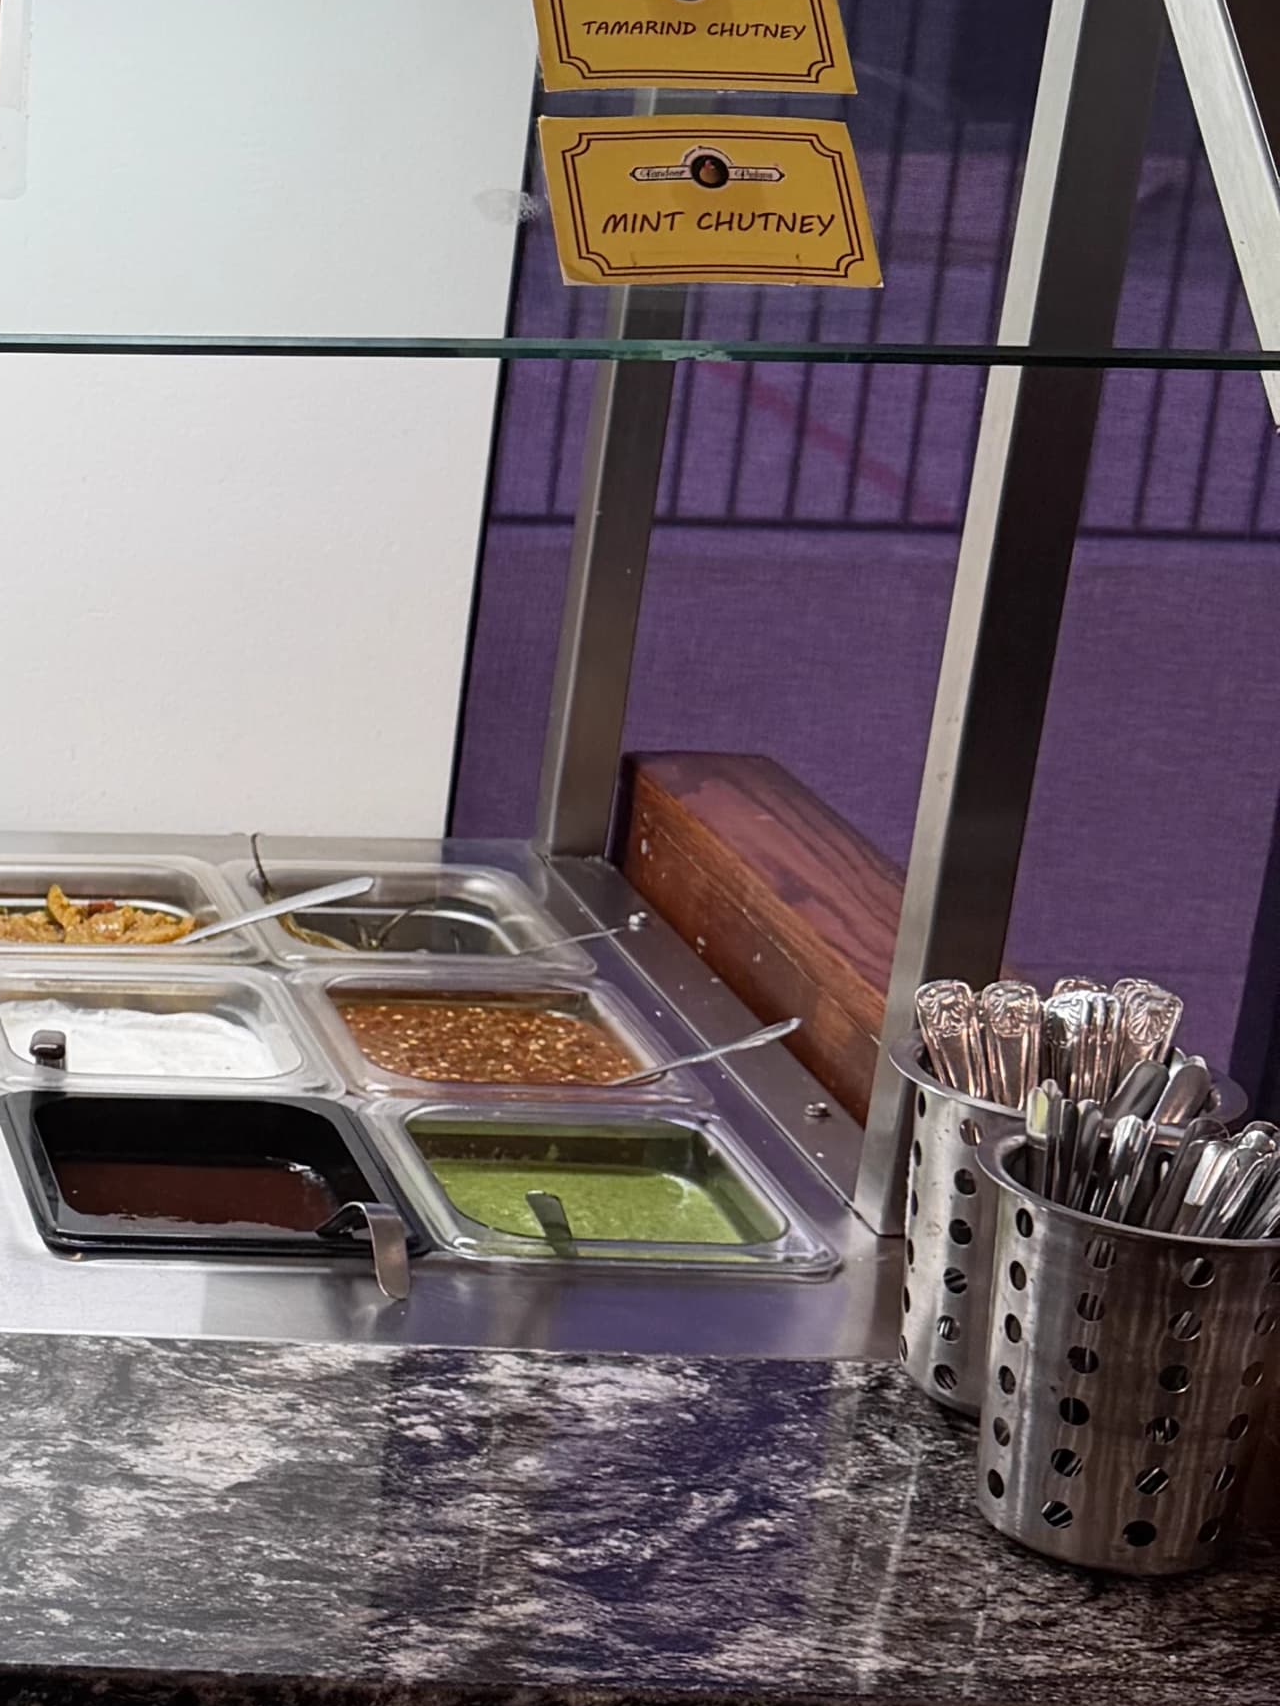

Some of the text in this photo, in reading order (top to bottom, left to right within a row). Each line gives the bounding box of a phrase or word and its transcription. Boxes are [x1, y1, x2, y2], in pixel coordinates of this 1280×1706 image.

[582, 20, 807, 41] TAMARIND CHUTNEY
[602, 211, 836, 238] MINT CHUTNEY
